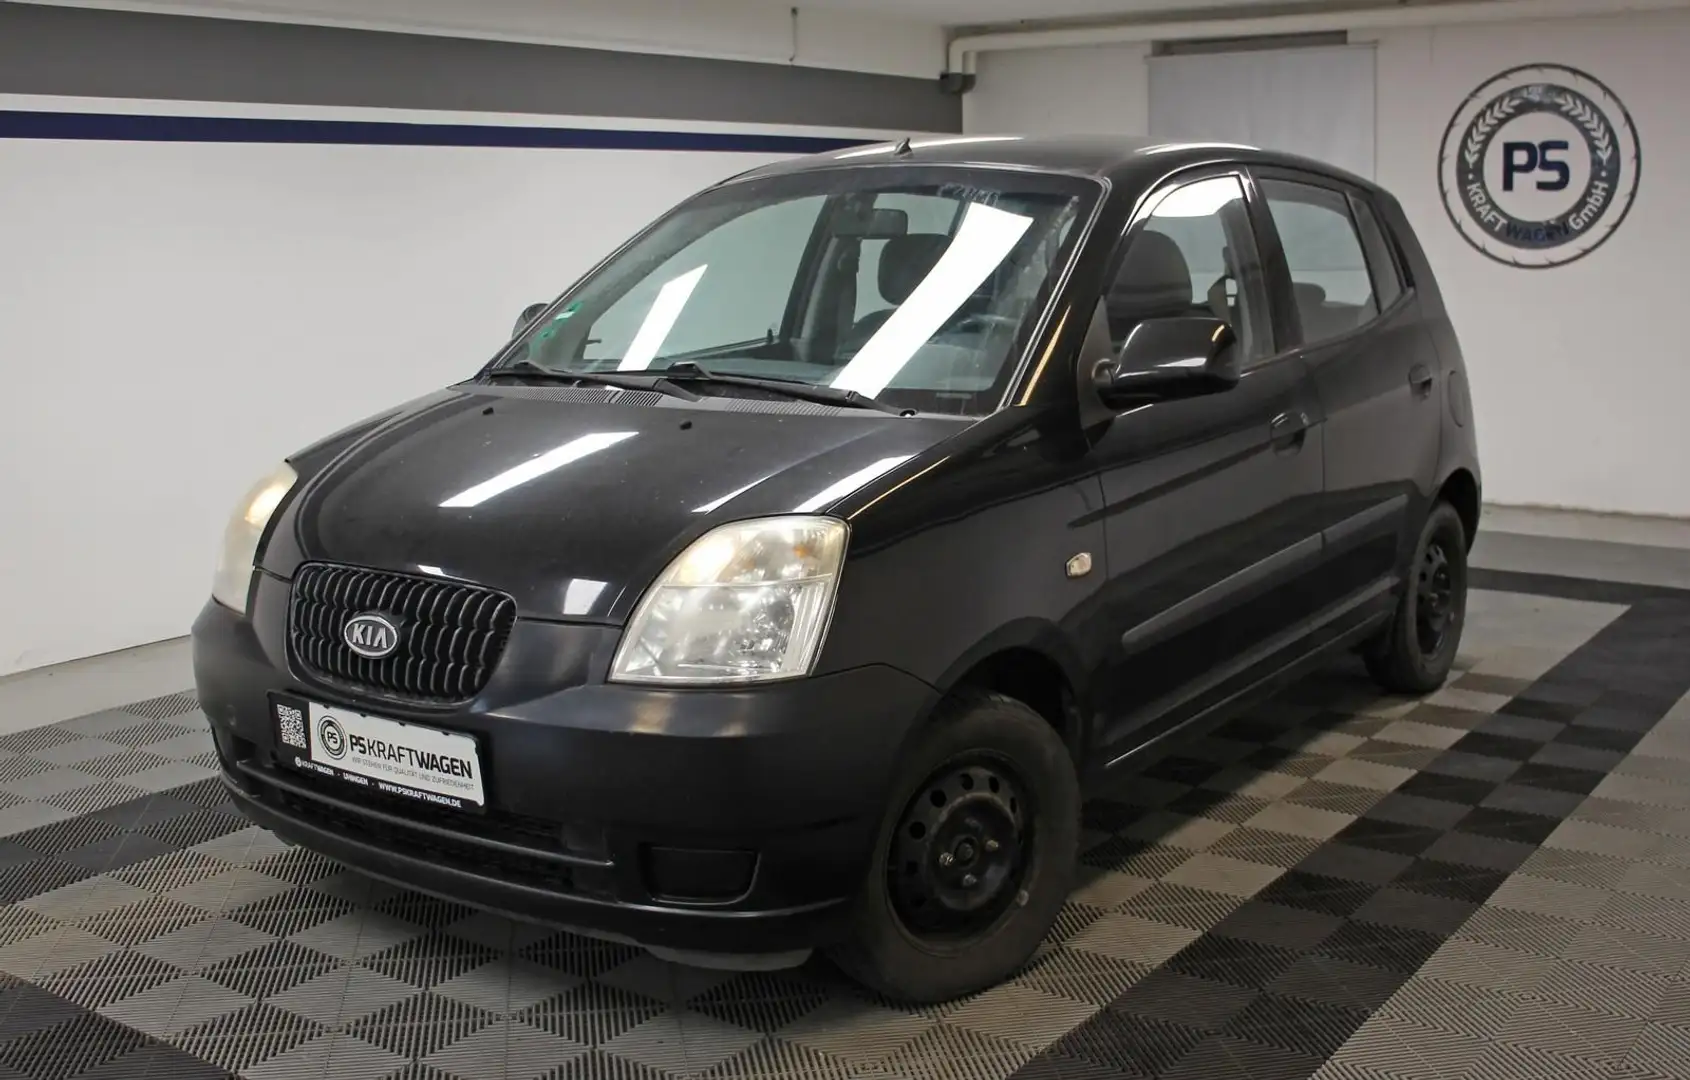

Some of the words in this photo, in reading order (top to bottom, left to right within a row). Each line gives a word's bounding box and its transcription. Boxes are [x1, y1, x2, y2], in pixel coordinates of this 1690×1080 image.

[1502, 140, 1570, 192] PS
[1569, 180, 1609, 230] GmbH
[352, 623, 388, 649] KIA
[326, 731, 338, 744] PS
